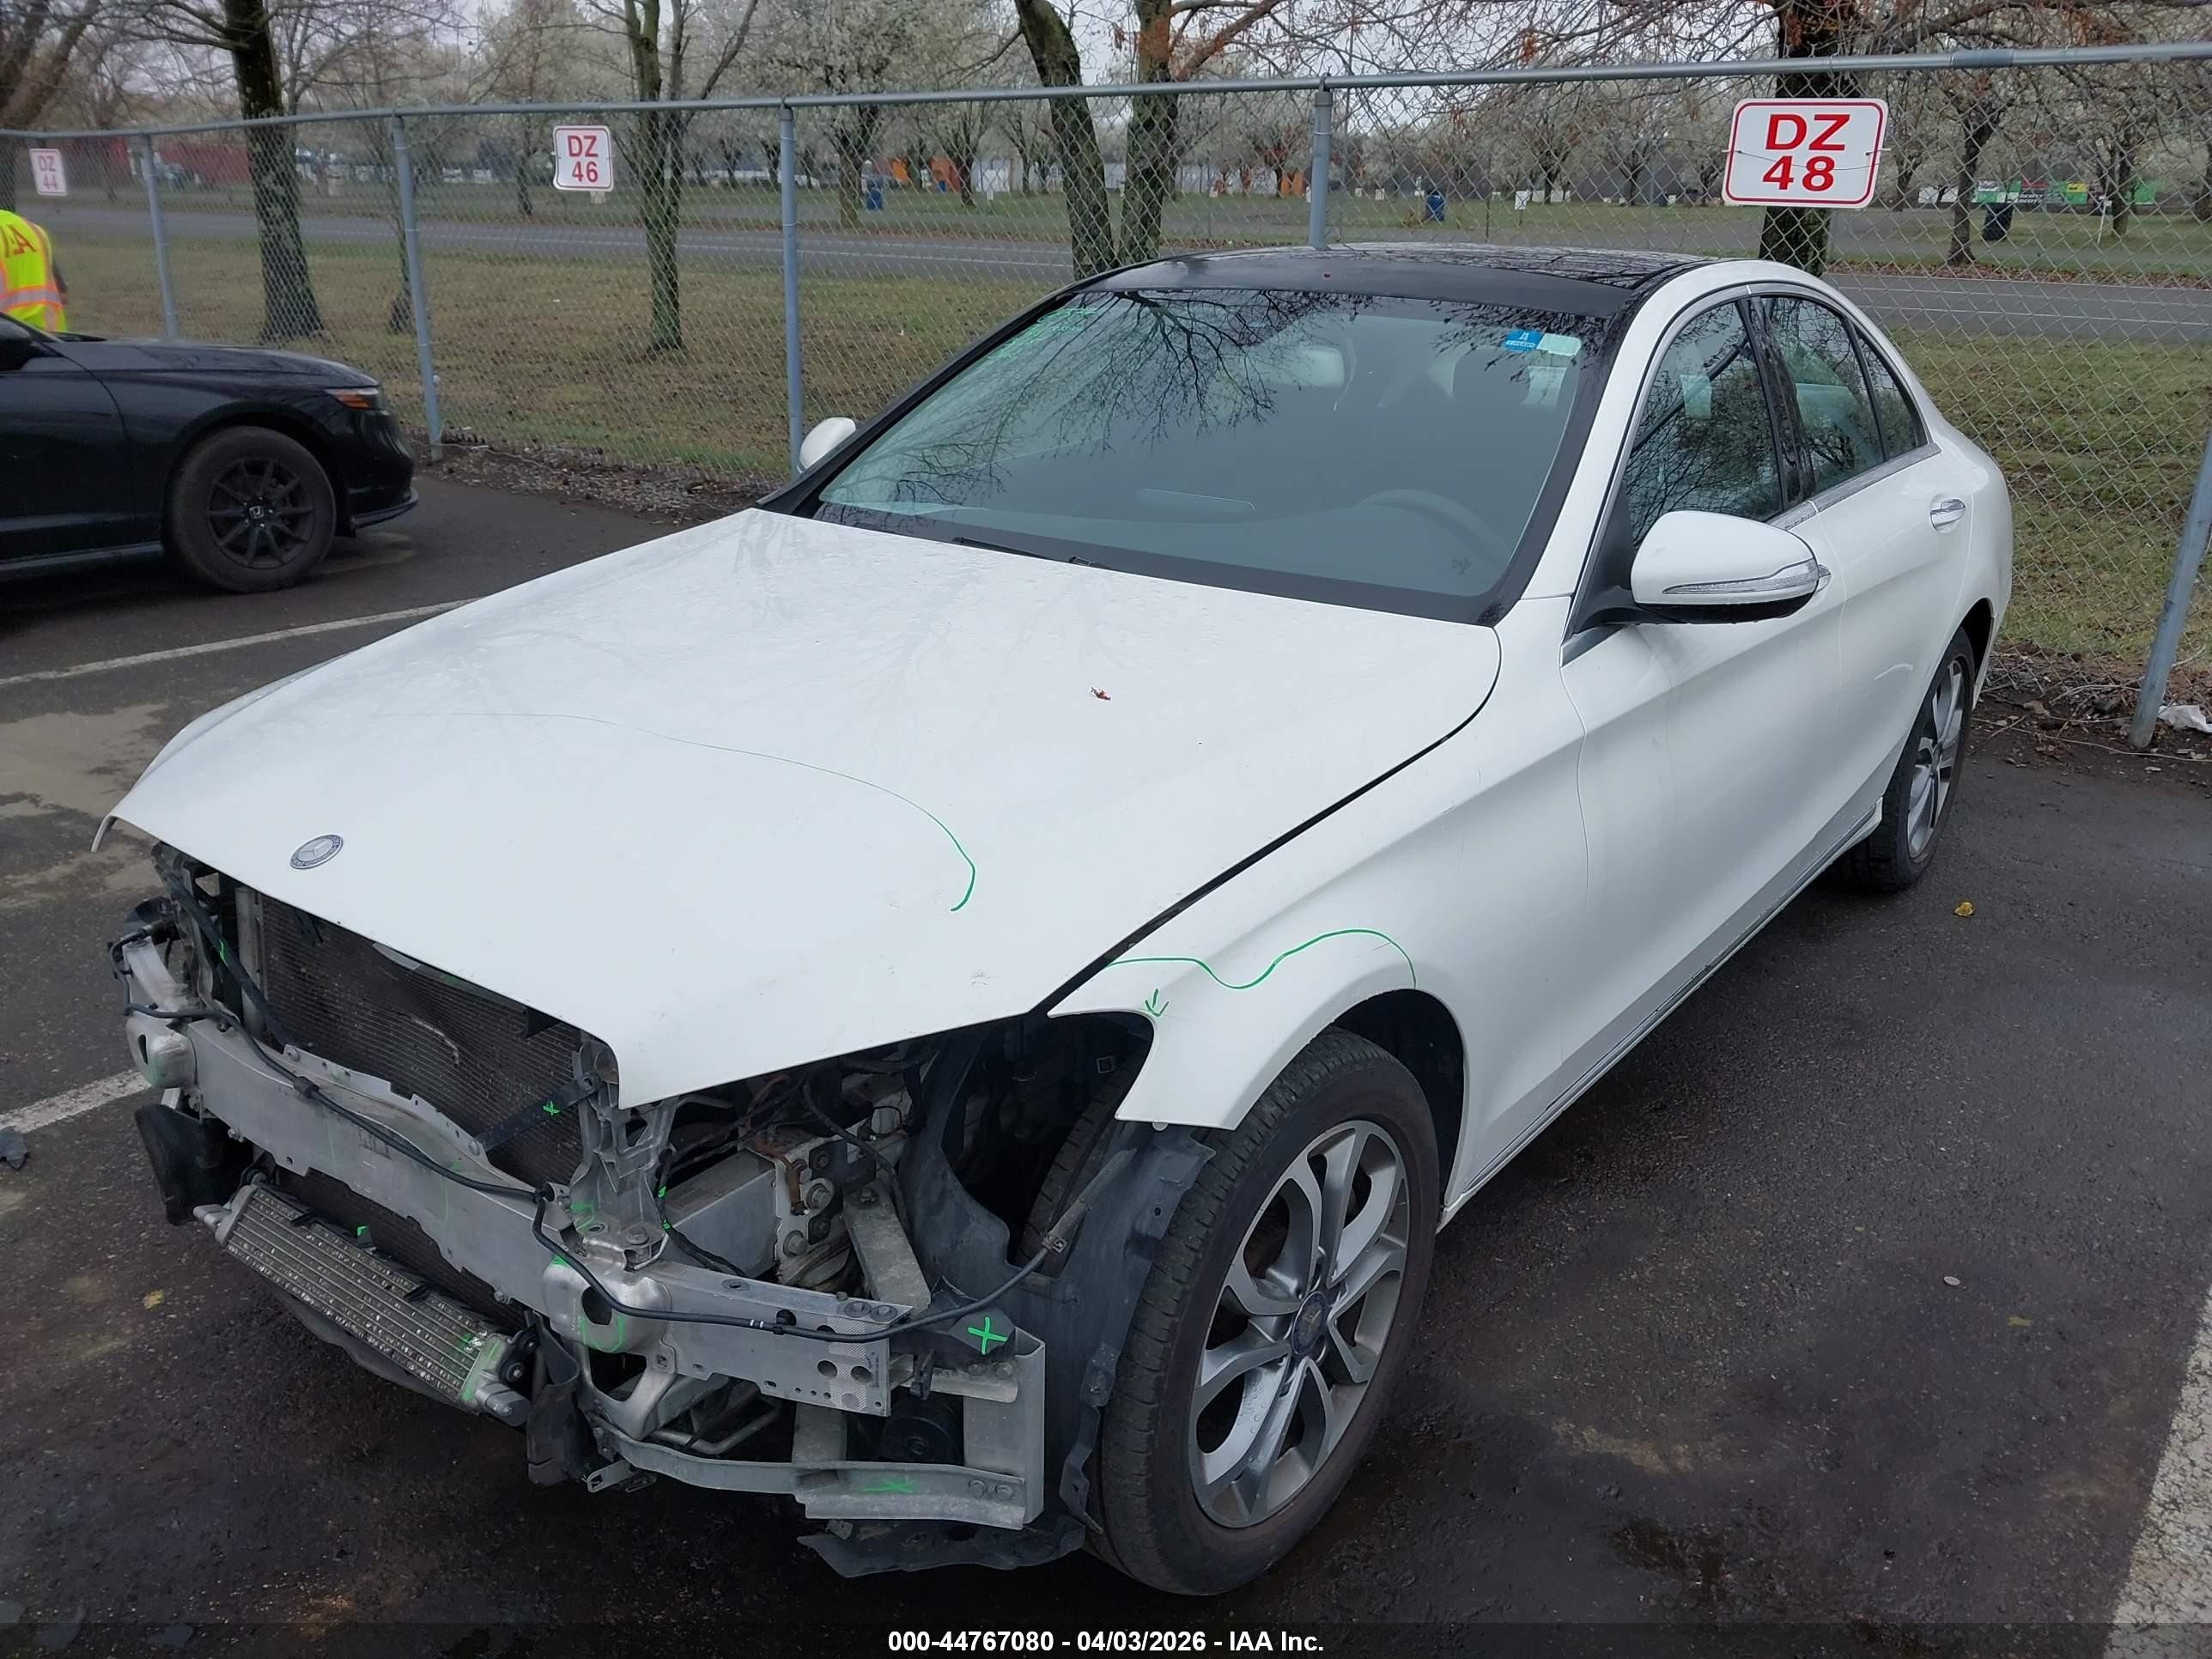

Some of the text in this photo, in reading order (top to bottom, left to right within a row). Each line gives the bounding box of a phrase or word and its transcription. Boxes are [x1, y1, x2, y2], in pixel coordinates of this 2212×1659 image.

[1765, 113, 1850, 151] DZ
[568, 135, 599, 157] DZ
[39, 155, 56, 172] DZ
[572, 161, 599, 183] 46
[1762, 155, 1835, 191] 48
[43, 174, 58, 189] 44
